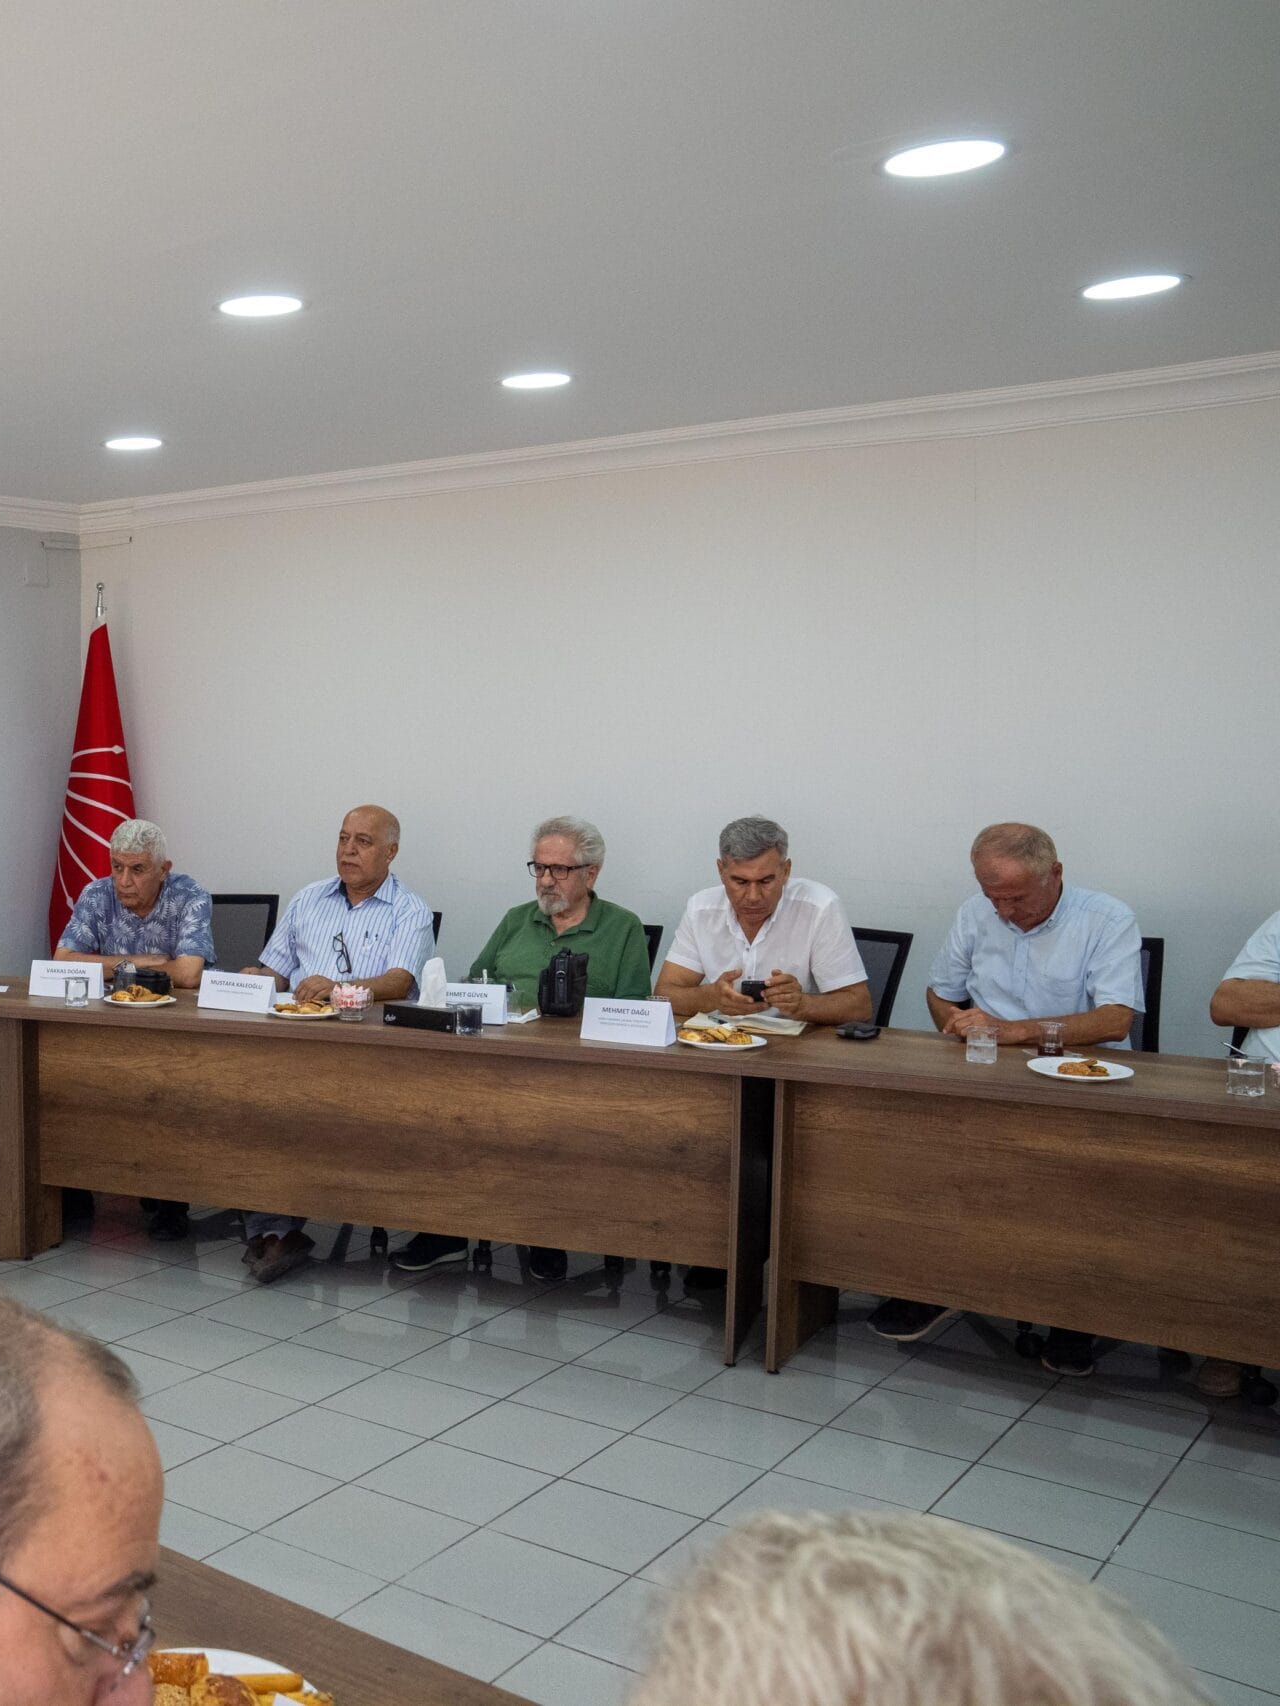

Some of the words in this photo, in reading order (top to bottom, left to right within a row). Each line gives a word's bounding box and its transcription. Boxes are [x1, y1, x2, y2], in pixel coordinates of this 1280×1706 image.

[210, 979, 235, 987] MUSTAFA
[602, 1006, 630, 1015] MEHMET
[631, 1008, 650, 1016] DAĞLI
